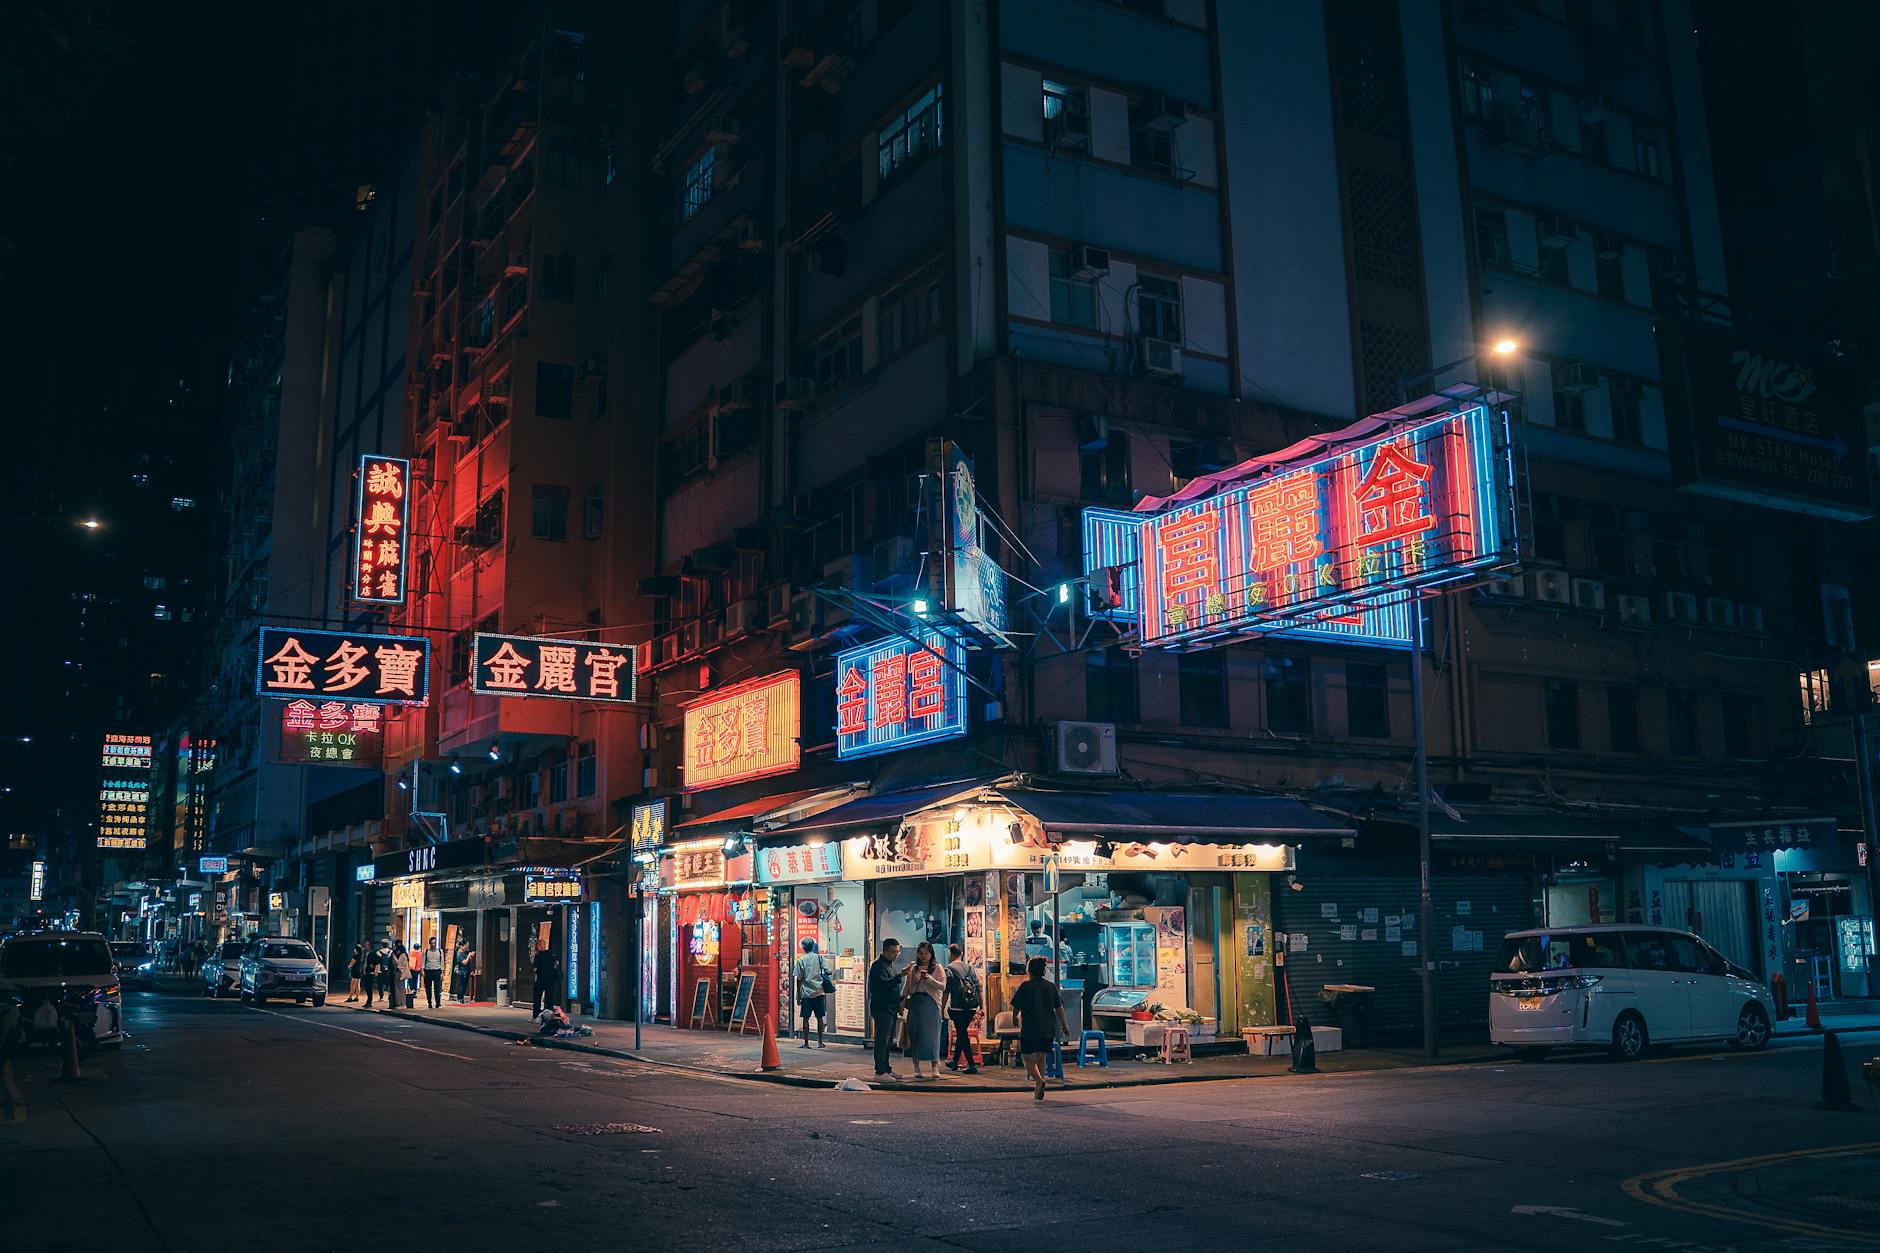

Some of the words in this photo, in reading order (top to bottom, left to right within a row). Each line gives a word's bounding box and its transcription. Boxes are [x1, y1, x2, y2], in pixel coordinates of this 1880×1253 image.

[1756, 438, 1793, 462] STAR
[1799, 447, 1839, 471] Hotel
[264, 636, 423, 697] 金多寶
[482, 640, 627, 698] 金麗宮
[836, 645, 945, 736] 金麗宮
[285, 698, 381, 733] 金多寶
[309, 746, 354, 760] 夜總會
